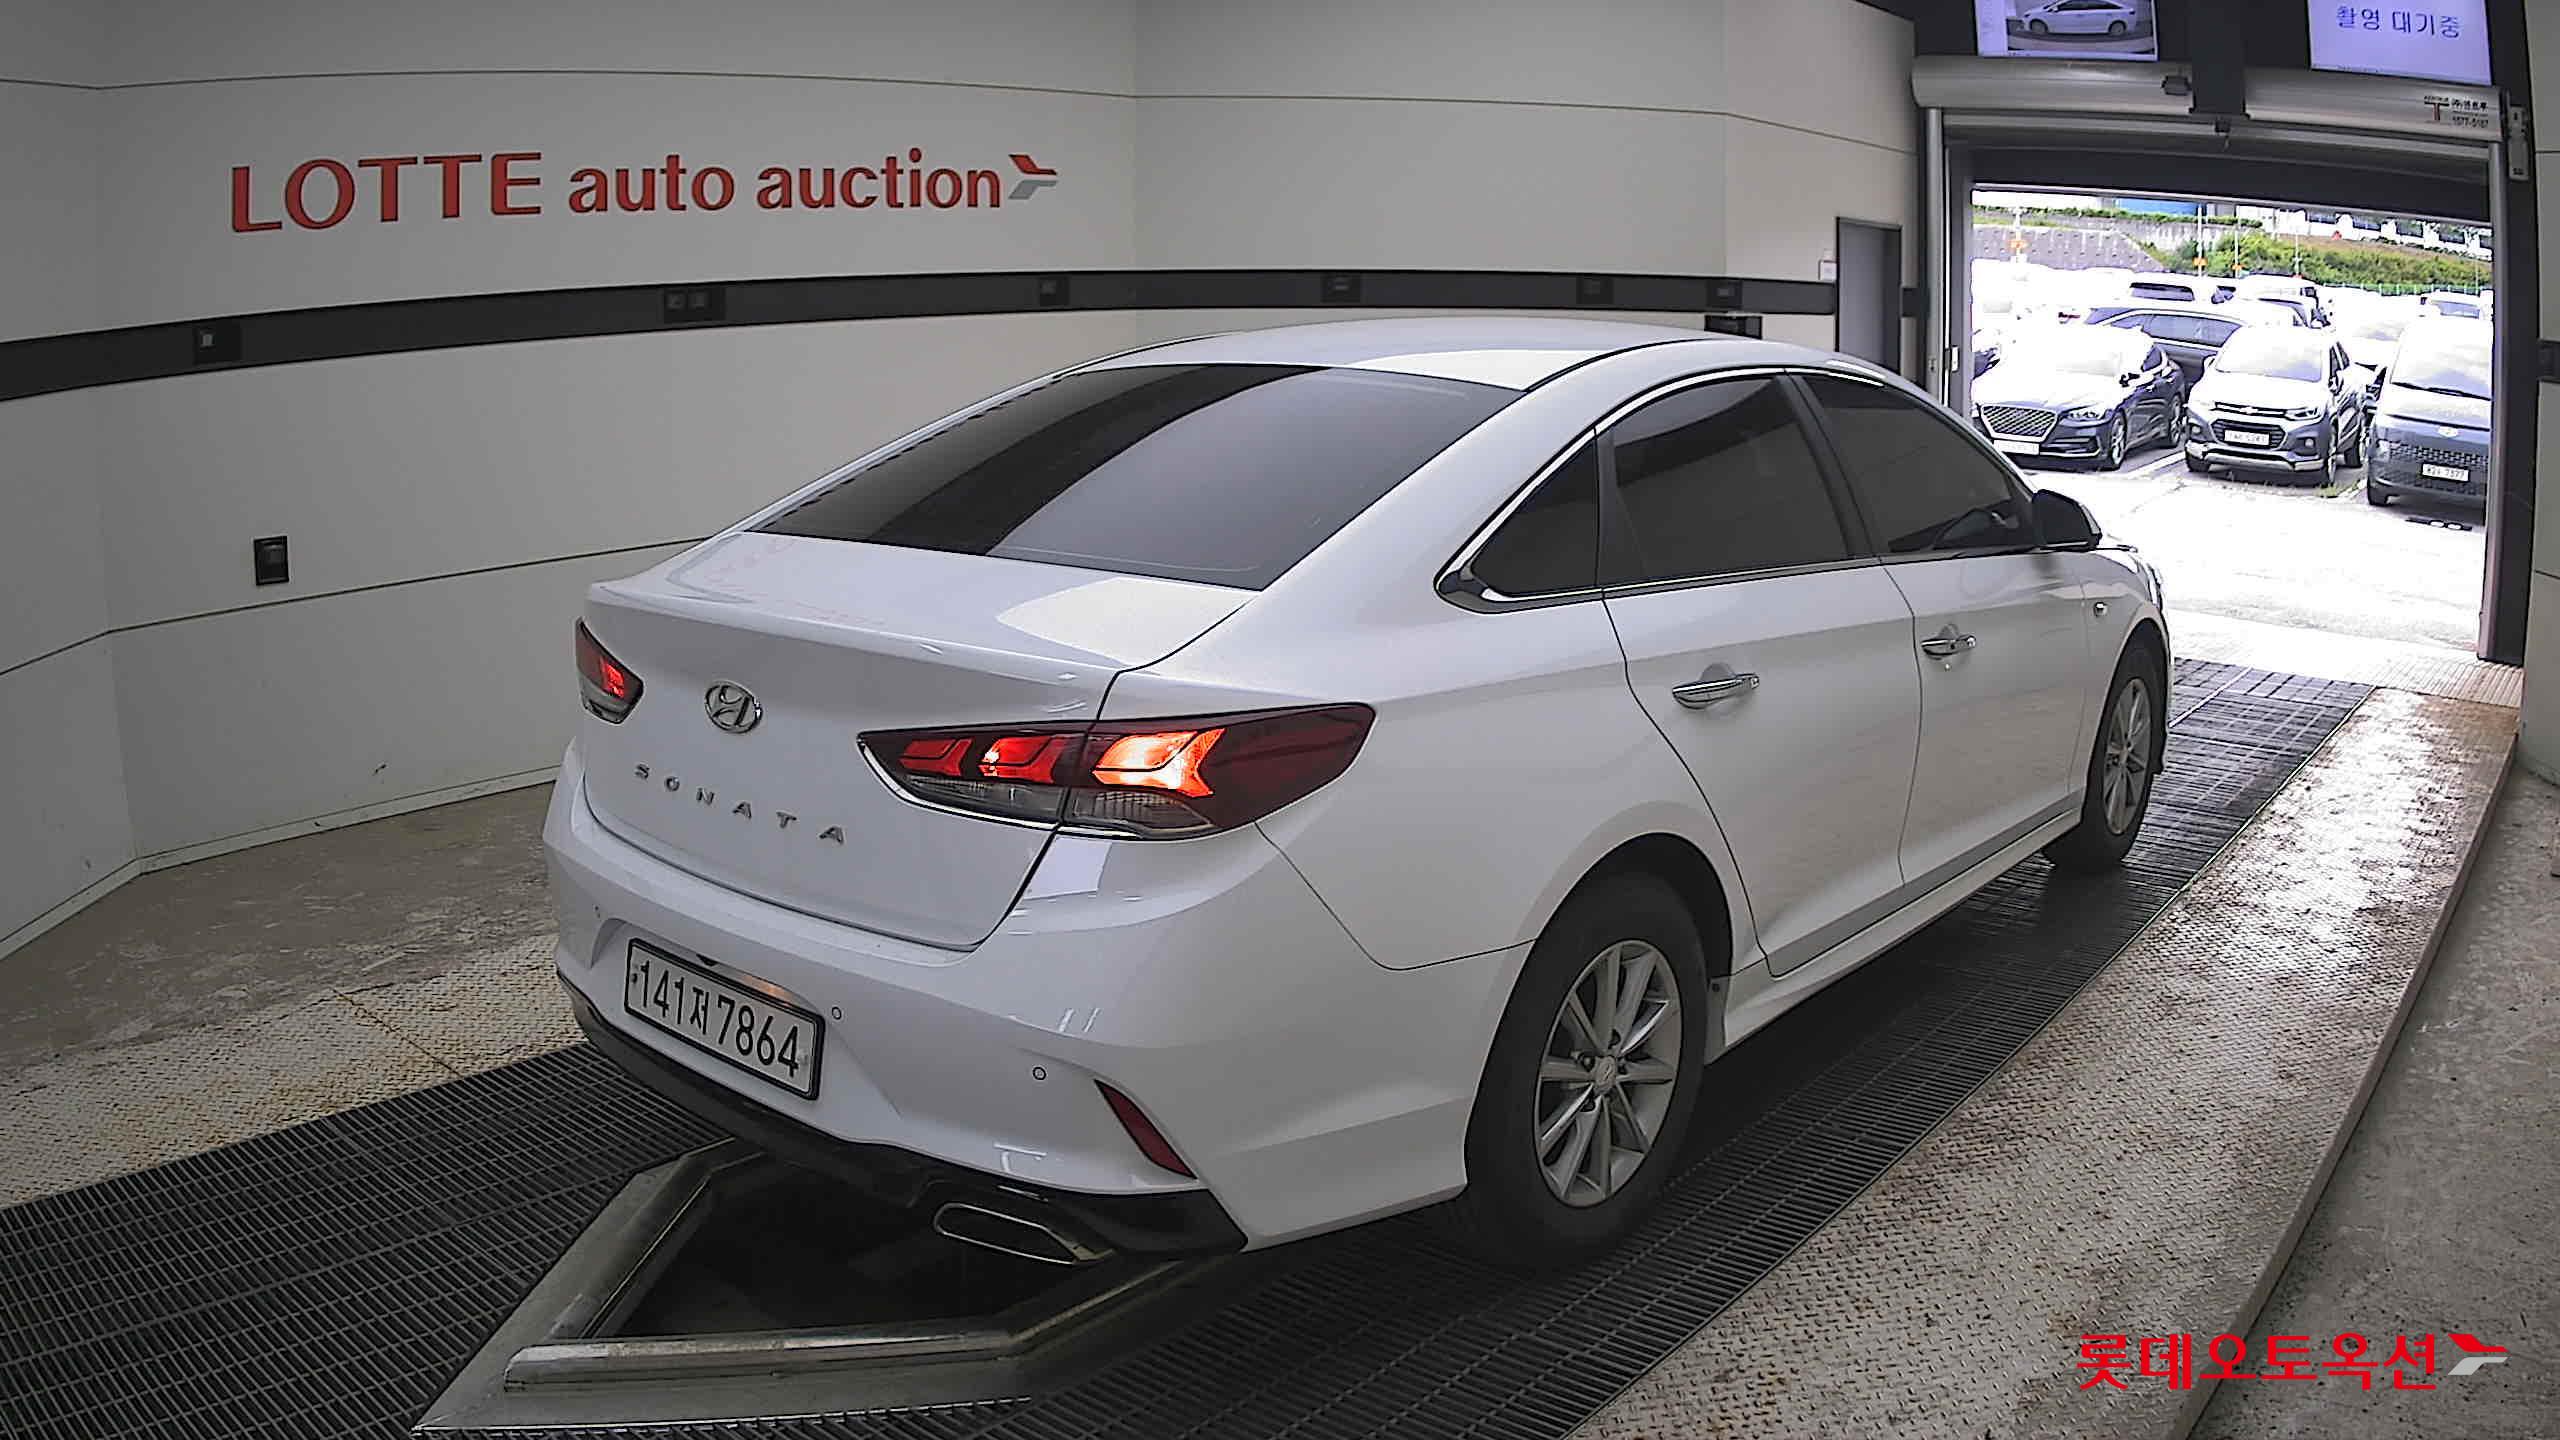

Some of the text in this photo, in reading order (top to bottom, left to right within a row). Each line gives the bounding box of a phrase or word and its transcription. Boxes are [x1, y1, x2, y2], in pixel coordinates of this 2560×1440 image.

[2336, 5, 2460, 39] 촬영 대기중
[231, 147, 1002, 233] LOTTE auto auction
[633, 763, 846, 846] SONATA
[639, 959, 800, 1079] 141저7864
